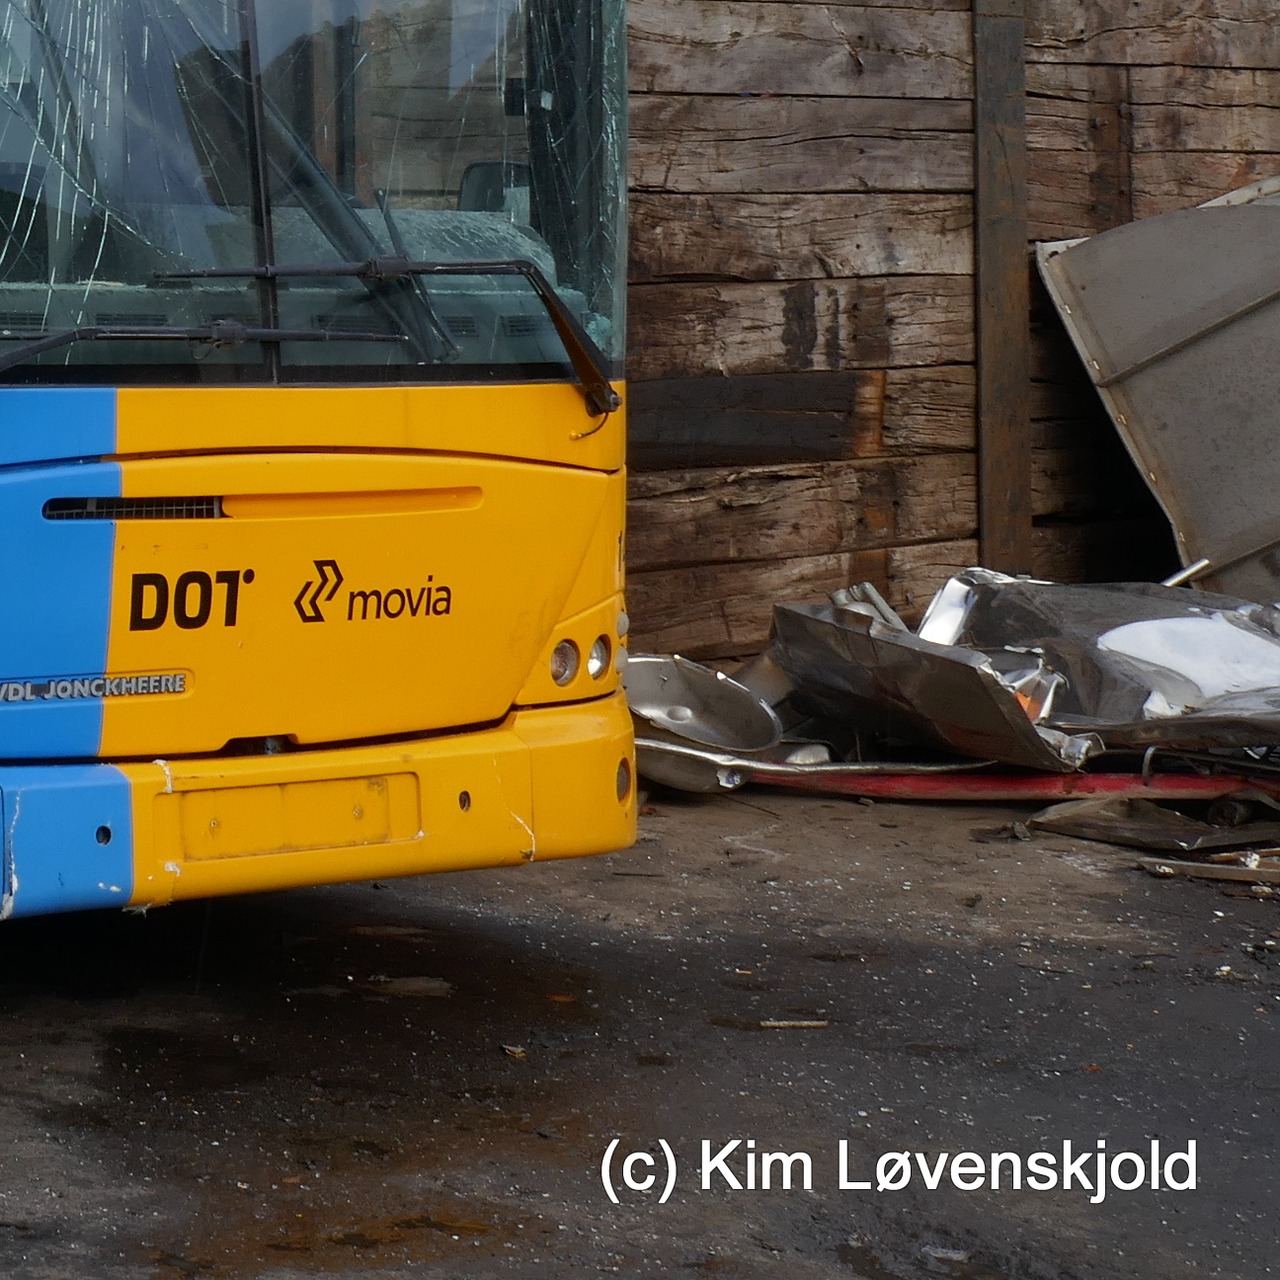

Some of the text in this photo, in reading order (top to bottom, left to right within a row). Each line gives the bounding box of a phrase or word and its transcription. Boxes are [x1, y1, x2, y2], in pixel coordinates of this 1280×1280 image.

[128, 568, 255, 631] DOT
[346, 574, 453, 622] movia
[43, 673, 188, 701] JONCKHEERE
